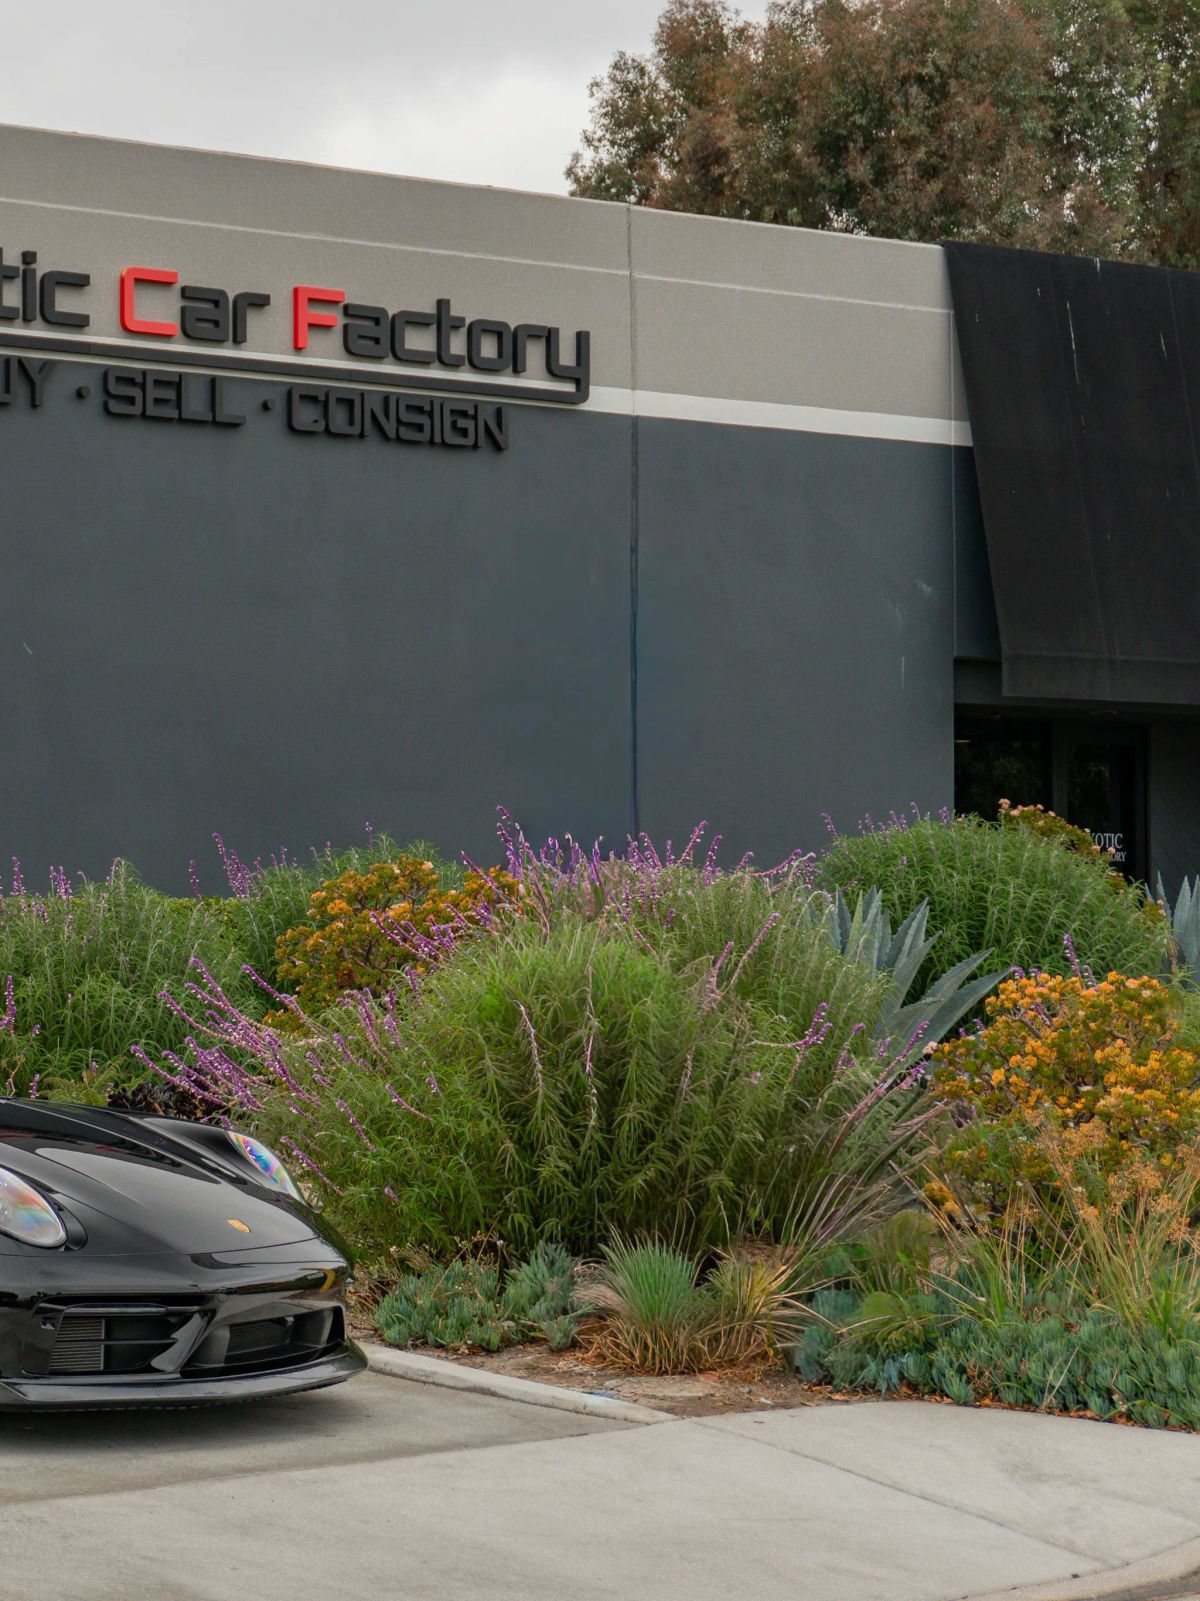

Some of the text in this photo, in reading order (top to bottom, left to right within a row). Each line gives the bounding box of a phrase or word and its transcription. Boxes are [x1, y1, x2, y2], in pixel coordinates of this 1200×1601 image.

[119, 266, 271, 343] Car
[293, 285, 591, 404] Factory
[103, 367, 246, 426] SELL
[287, 386, 510, 450] CONSIGN
[1090, 832, 1124, 849] OTIC
